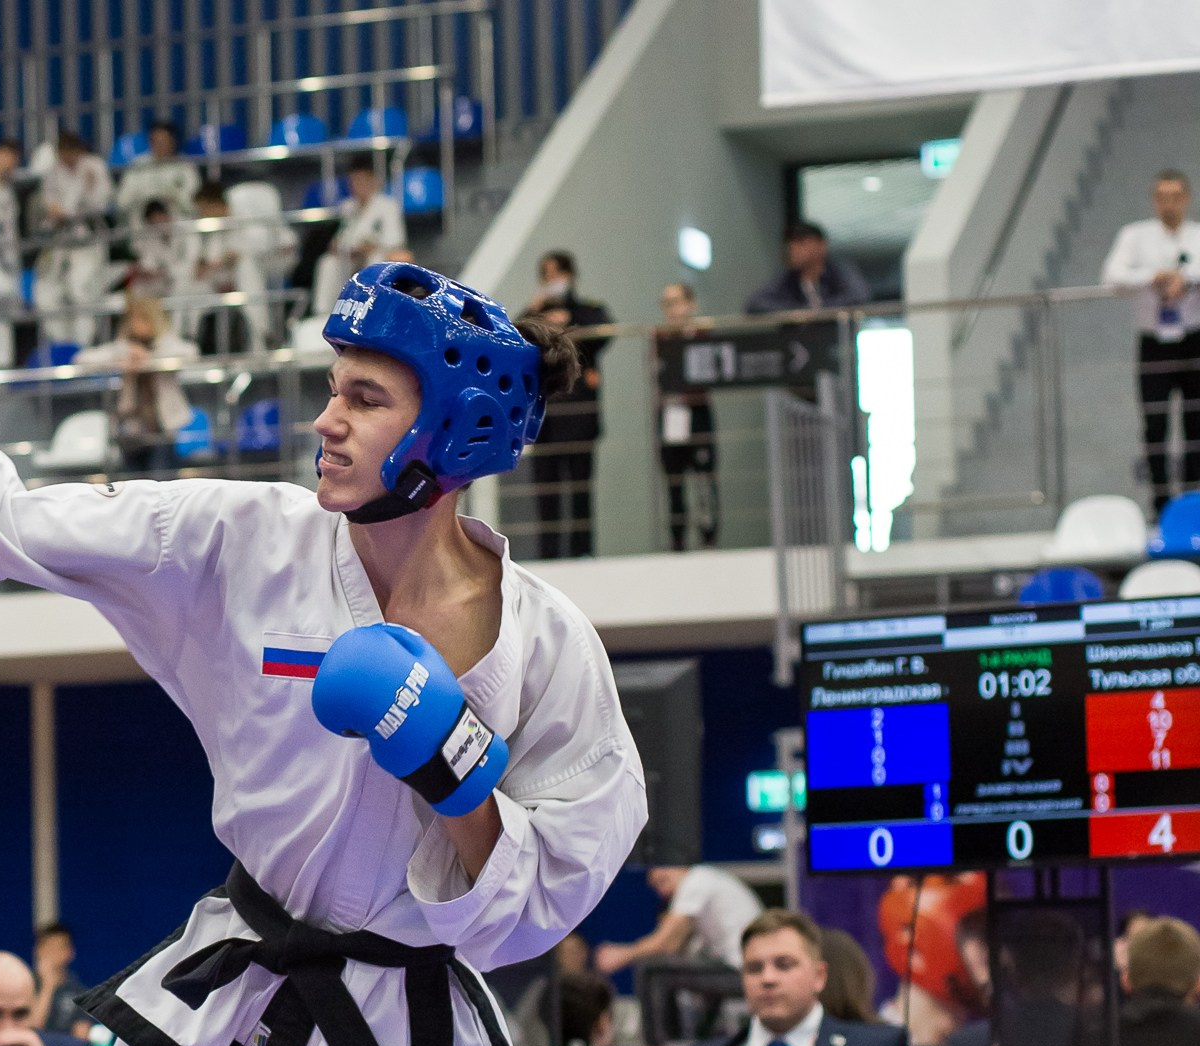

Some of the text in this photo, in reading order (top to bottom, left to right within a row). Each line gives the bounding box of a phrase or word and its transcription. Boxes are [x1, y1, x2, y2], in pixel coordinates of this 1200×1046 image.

[374, 661, 430, 740] MAX PRO
[978, 668, 1052, 699] 01:02
[1151, 690, 1166, 709] 4
[868, 826, 895, 868] 0
[1006, 819, 1035, 861] 0
[1147, 813, 1177, 853] 4
